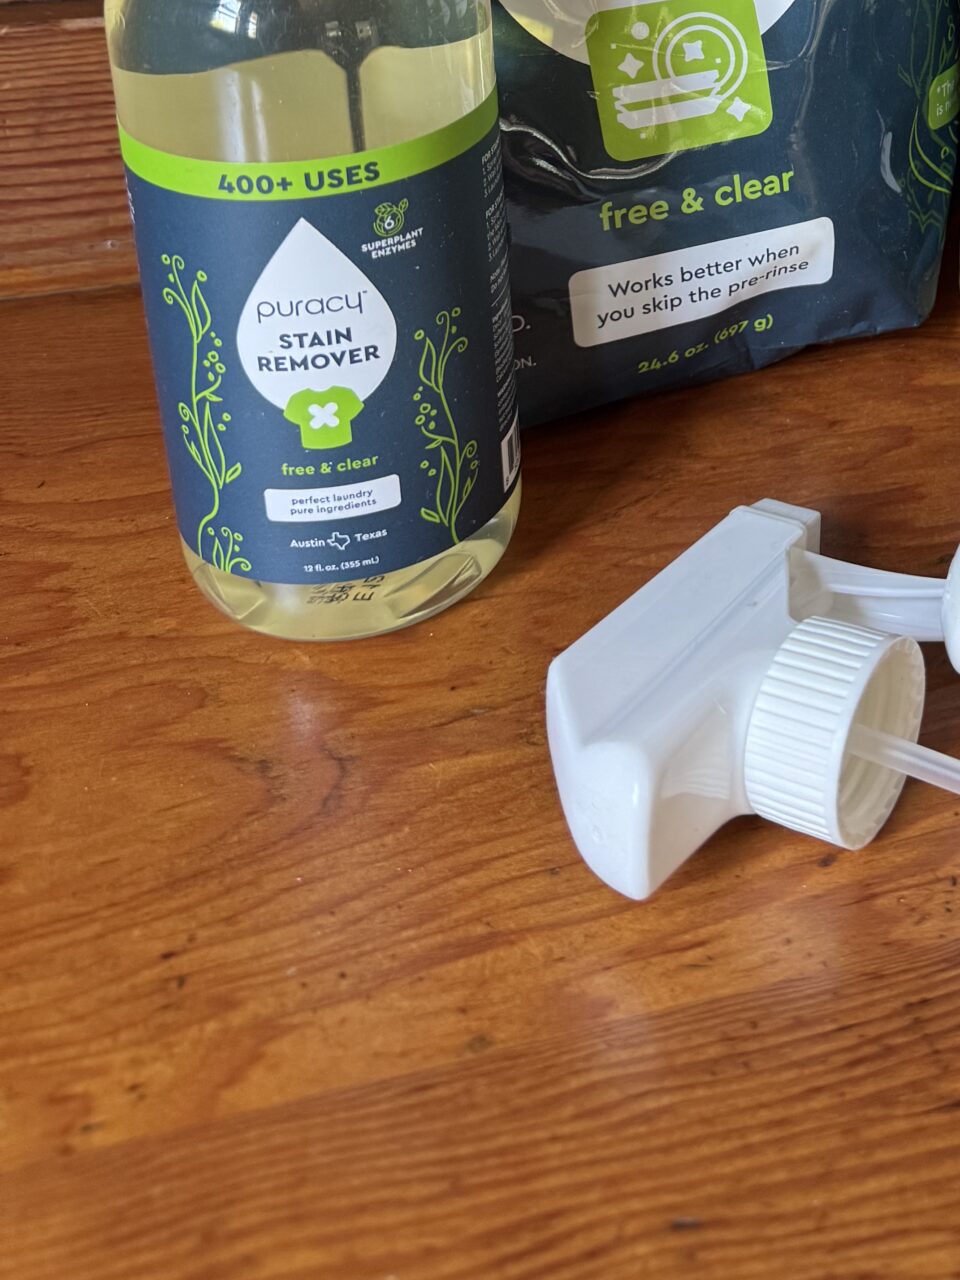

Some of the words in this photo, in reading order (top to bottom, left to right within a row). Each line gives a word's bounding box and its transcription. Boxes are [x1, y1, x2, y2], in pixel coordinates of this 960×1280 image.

[217, 173, 293, 196] 400+
[303, 161, 381, 193] USES
[600, 199, 670, 231] free
[681, 187, 705, 215] &
[714, 168, 795, 207] clear
[384, 214, 395, 230] 6
[361, 227, 424, 254] SUPERPLANT
[371, 238, 417, 259] ENZYMES
[608, 267, 674, 299] Works
[680, 256, 742, 284] better
[747, 243, 801, 267] when
[597, 303, 636, 328] you
[641, 290, 682, 318] skip
[688, 283, 722, 305] the
[728, 258, 809, 298] pre-rinse
[278, 327, 353, 350] STAIN
[637, 349, 679, 374] 24.6
[683, 340, 709, 360] oz.
[714, 319, 749, 344] (697
[753, 313, 774, 332] g)
[257, 345, 381, 373] REMOVER
[281, 461, 315, 477] free
[319, 460, 333, 474] &
[336, 454, 379, 472] clear
[290, 505, 315, 516] pure
[316, 498, 377, 516] ingredients
[291, 491, 329, 507] perfect
[332, 487, 373, 504] laundry
[290, 536, 325, 549] Austin
[354, 528, 388, 542] Texas
[303, 564, 314, 573] 12
[340, 560, 360, 570] (355
[362, 556, 380, 567] mL)
